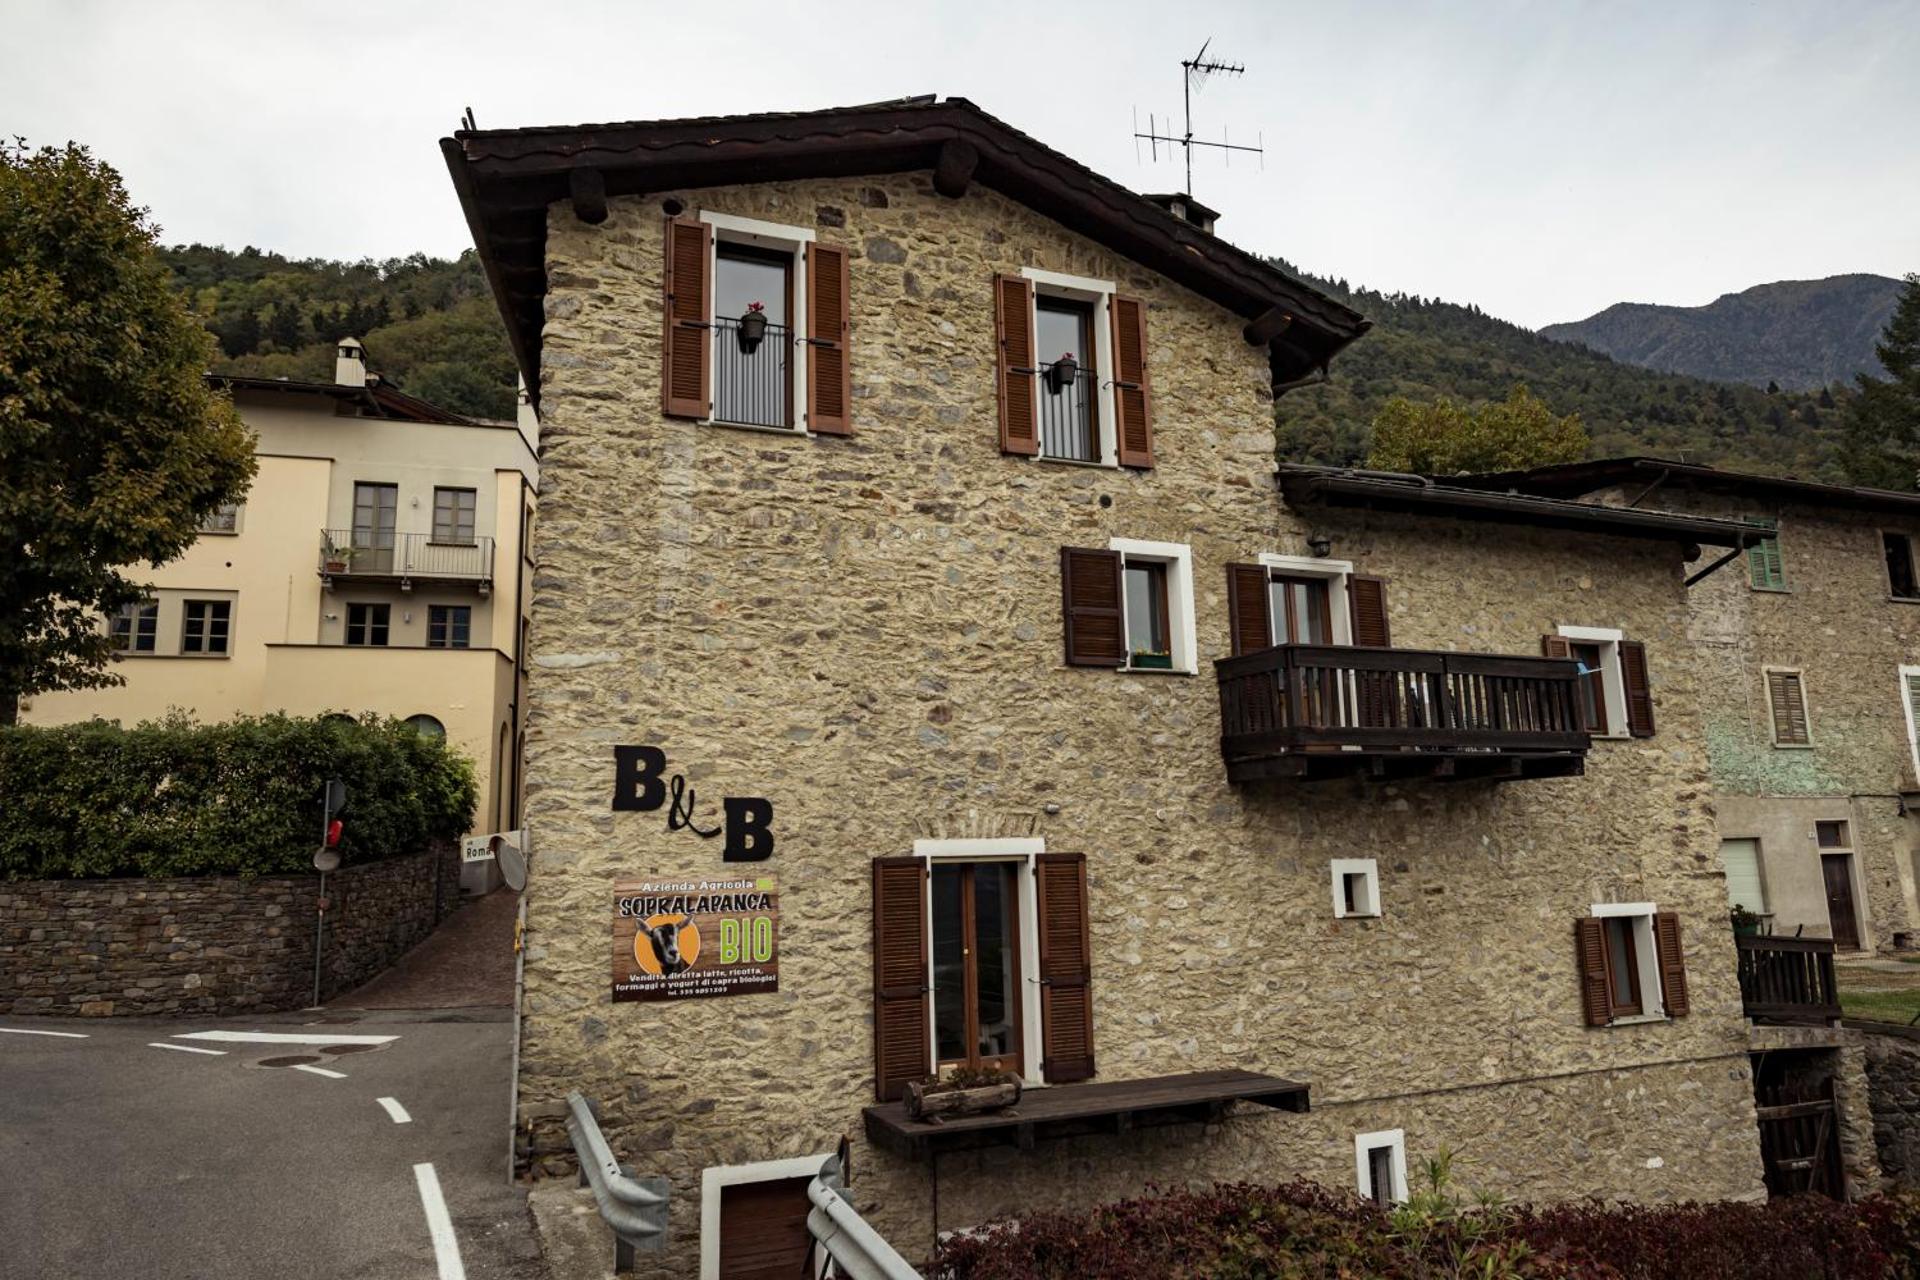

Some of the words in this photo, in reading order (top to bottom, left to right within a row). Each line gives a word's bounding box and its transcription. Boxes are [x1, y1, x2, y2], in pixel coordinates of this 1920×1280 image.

[611, 744, 775, 863] B&B
[466, 847, 491, 859] Roma
[642, 881, 696, 893] Azienda
[699, 879, 754, 892] Agricola
[619, 892, 772, 917] SOPRALAPANCA
[720, 917, 773, 965] BIO
[615, 982, 658, 992] formaggi
[668, 980, 699, 990] yogurt
[701, 978, 710, 987] di
[712, 977, 738, 987] capra
[629, 974, 667, 983] Vendita
[667, 972, 701, 980] diretta
